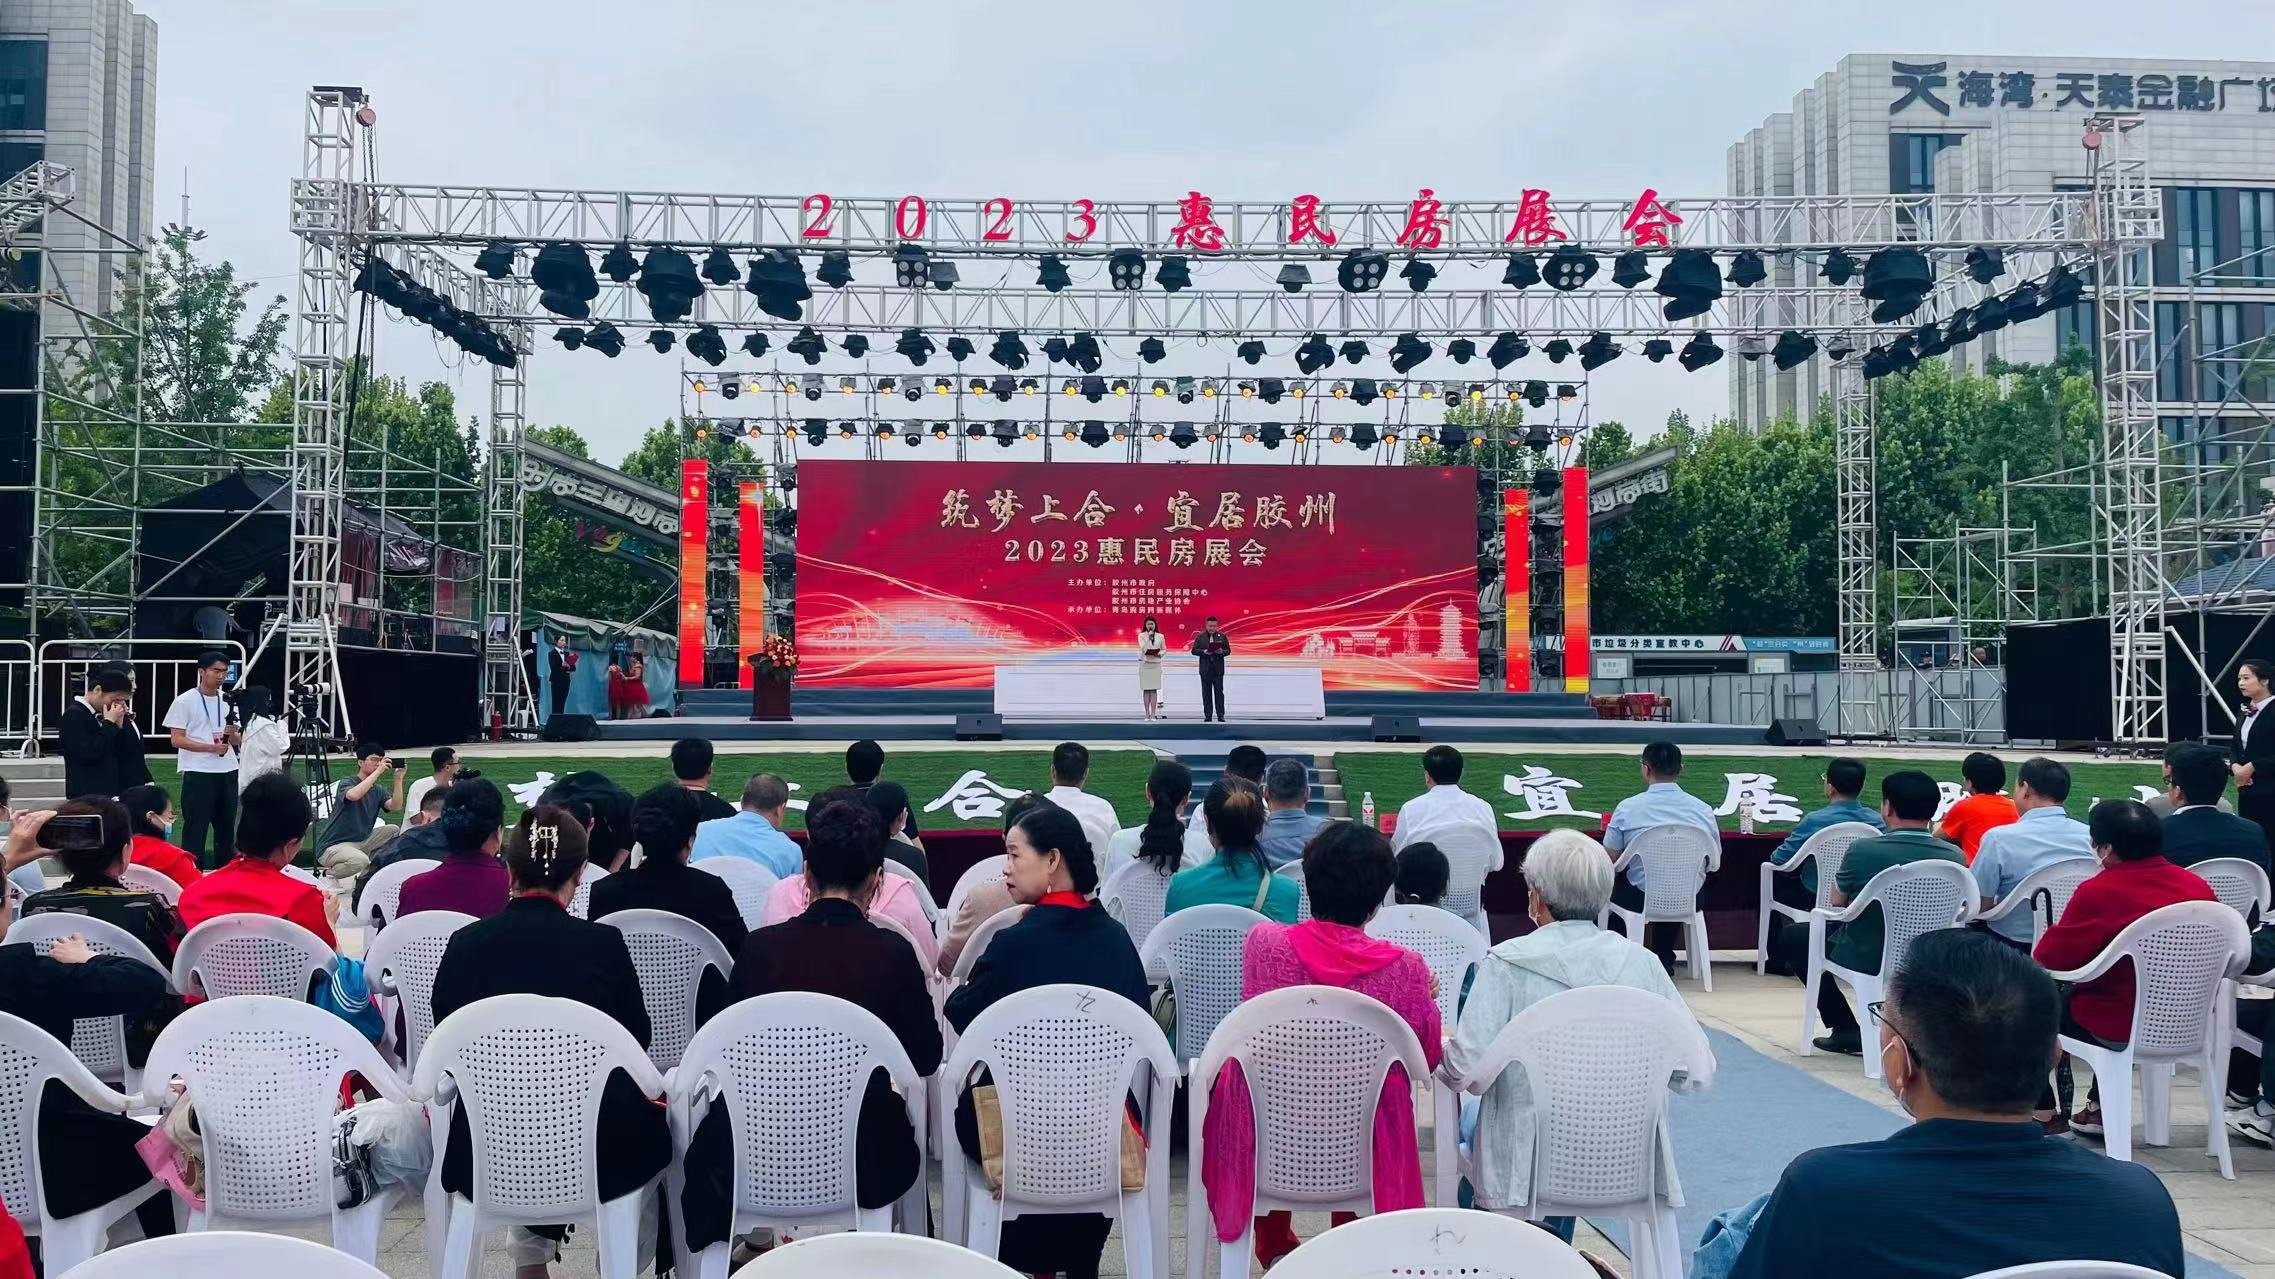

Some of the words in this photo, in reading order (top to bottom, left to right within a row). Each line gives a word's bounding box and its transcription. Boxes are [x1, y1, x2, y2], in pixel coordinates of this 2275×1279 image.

[802, 189, 1682, 249] 2023惠民房展会
[1004, 537, 1268, 568] 2023惠民房展会
